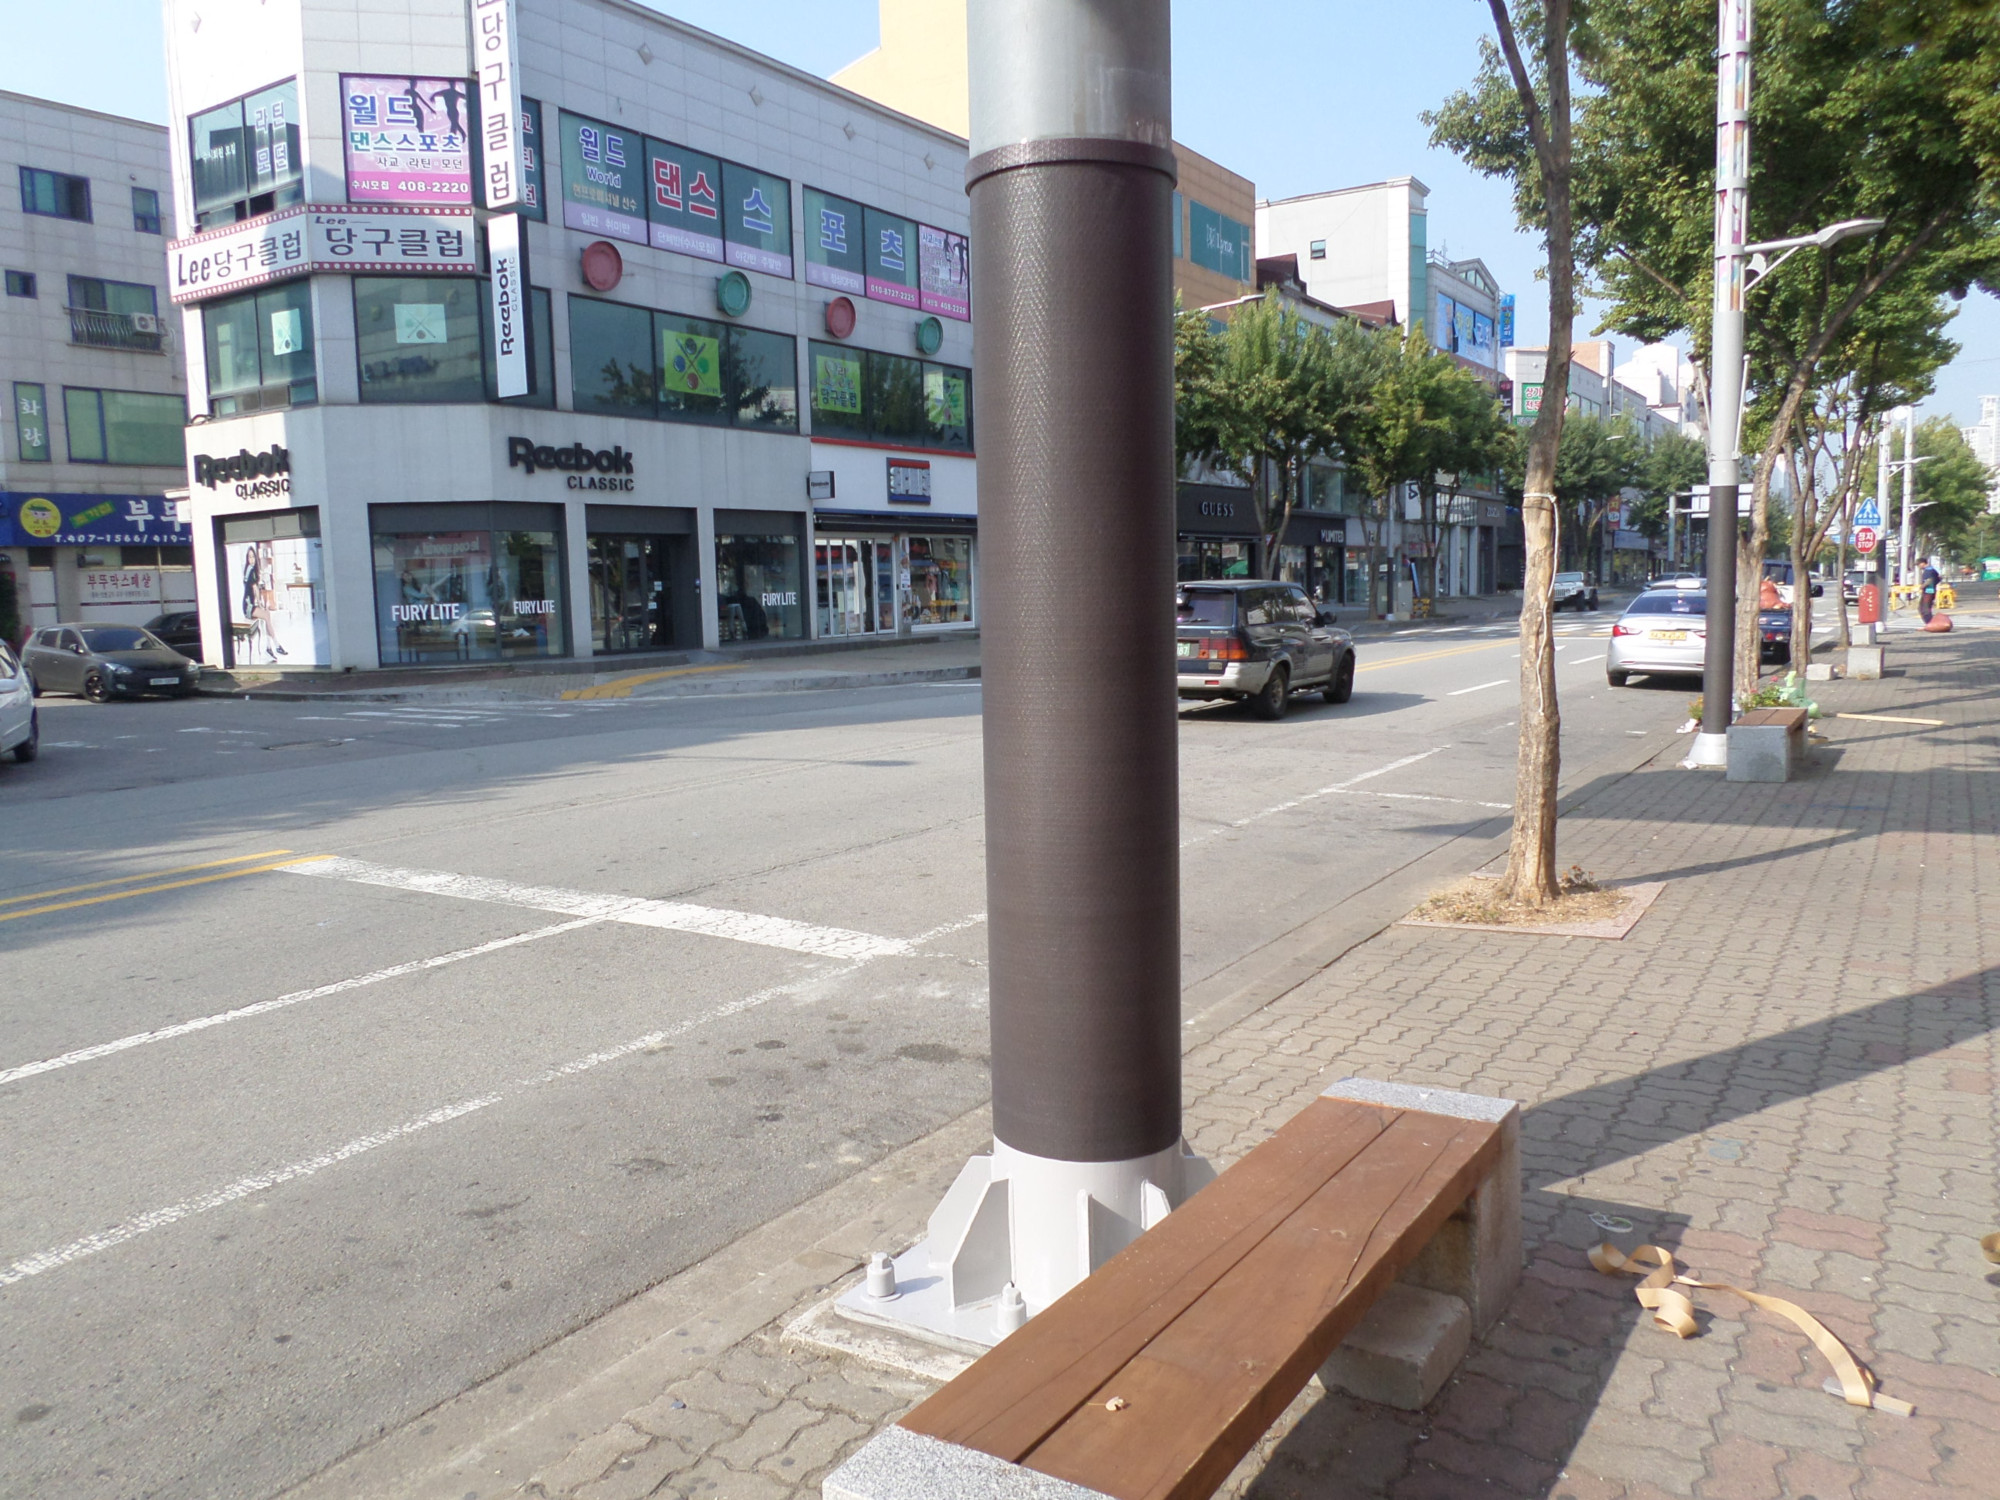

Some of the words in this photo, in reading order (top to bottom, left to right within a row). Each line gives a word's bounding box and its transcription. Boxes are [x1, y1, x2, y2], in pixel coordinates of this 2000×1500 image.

[349, 94, 417, 126] 월드
[482, 12, 510, 201] 당구클럽
[350, 132, 462, 153] 댄스스포츠
[579, 126, 626, 168] 월드
[377, 157, 399, 167] 사교
[409, 158, 431, 169] 라틴
[352, 181, 389, 190] 수시모집
[398, 181, 469, 193] 408-2220
[586, 165, 622, 189] World
[315, 216, 347, 225] Lee
[326, 228, 463, 258] 당구클럽
[508, 256, 518, 312] CLASSIC
[496, 257, 515, 356] Reebok
[194, 443, 290, 490] Reebok
[508, 436, 634, 475] Reebok
[236, 478, 290, 498] CLASSIC
[567, 475, 635, 492] CLASSIC
[1202, 501, 1234, 517] GUESS
[1858, 532, 1873, 541] 정지
[1858, 541, 1873, 549] STOP
